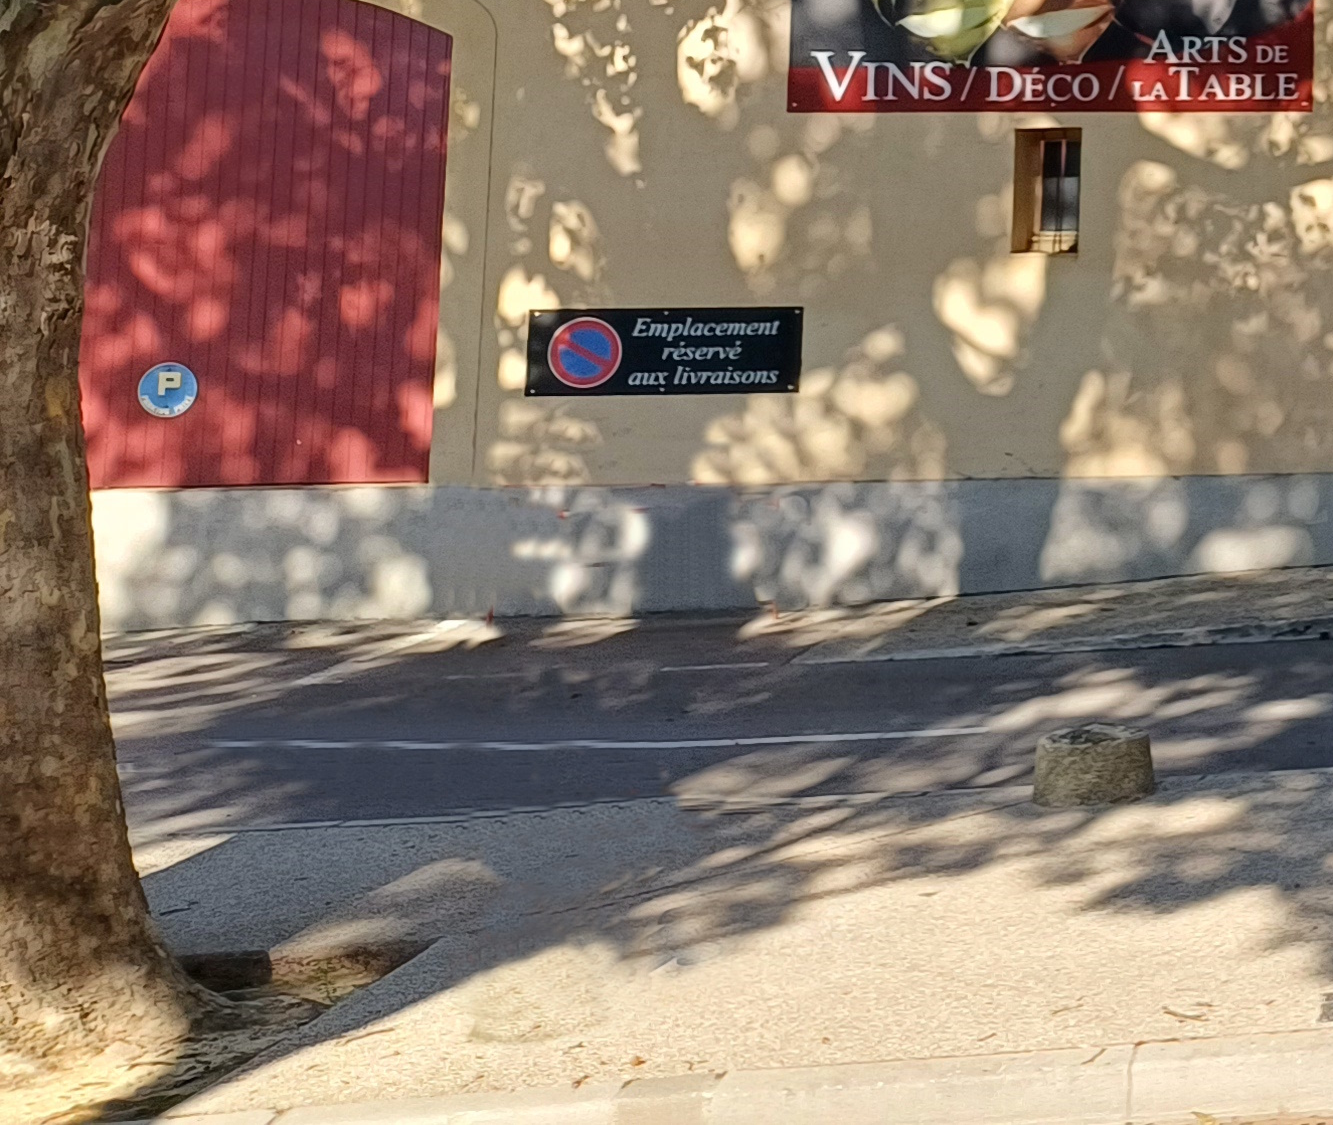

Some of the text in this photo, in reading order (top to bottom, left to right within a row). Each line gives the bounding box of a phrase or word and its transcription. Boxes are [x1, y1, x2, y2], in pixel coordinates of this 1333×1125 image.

[1143, 29, 1289, 64] ARTS DE
[810, 50, 952, 102] VINS
[985, 67, 1100, 103] DÉCO
[1131, 66, 1299, 101] LA TABLE
[631, 317, 780, 342] Emplacement
[661, 340, 743, 361] réservé
[157, 371, 182, 396] P
[627, 365, 780, 386] aux livraisons
